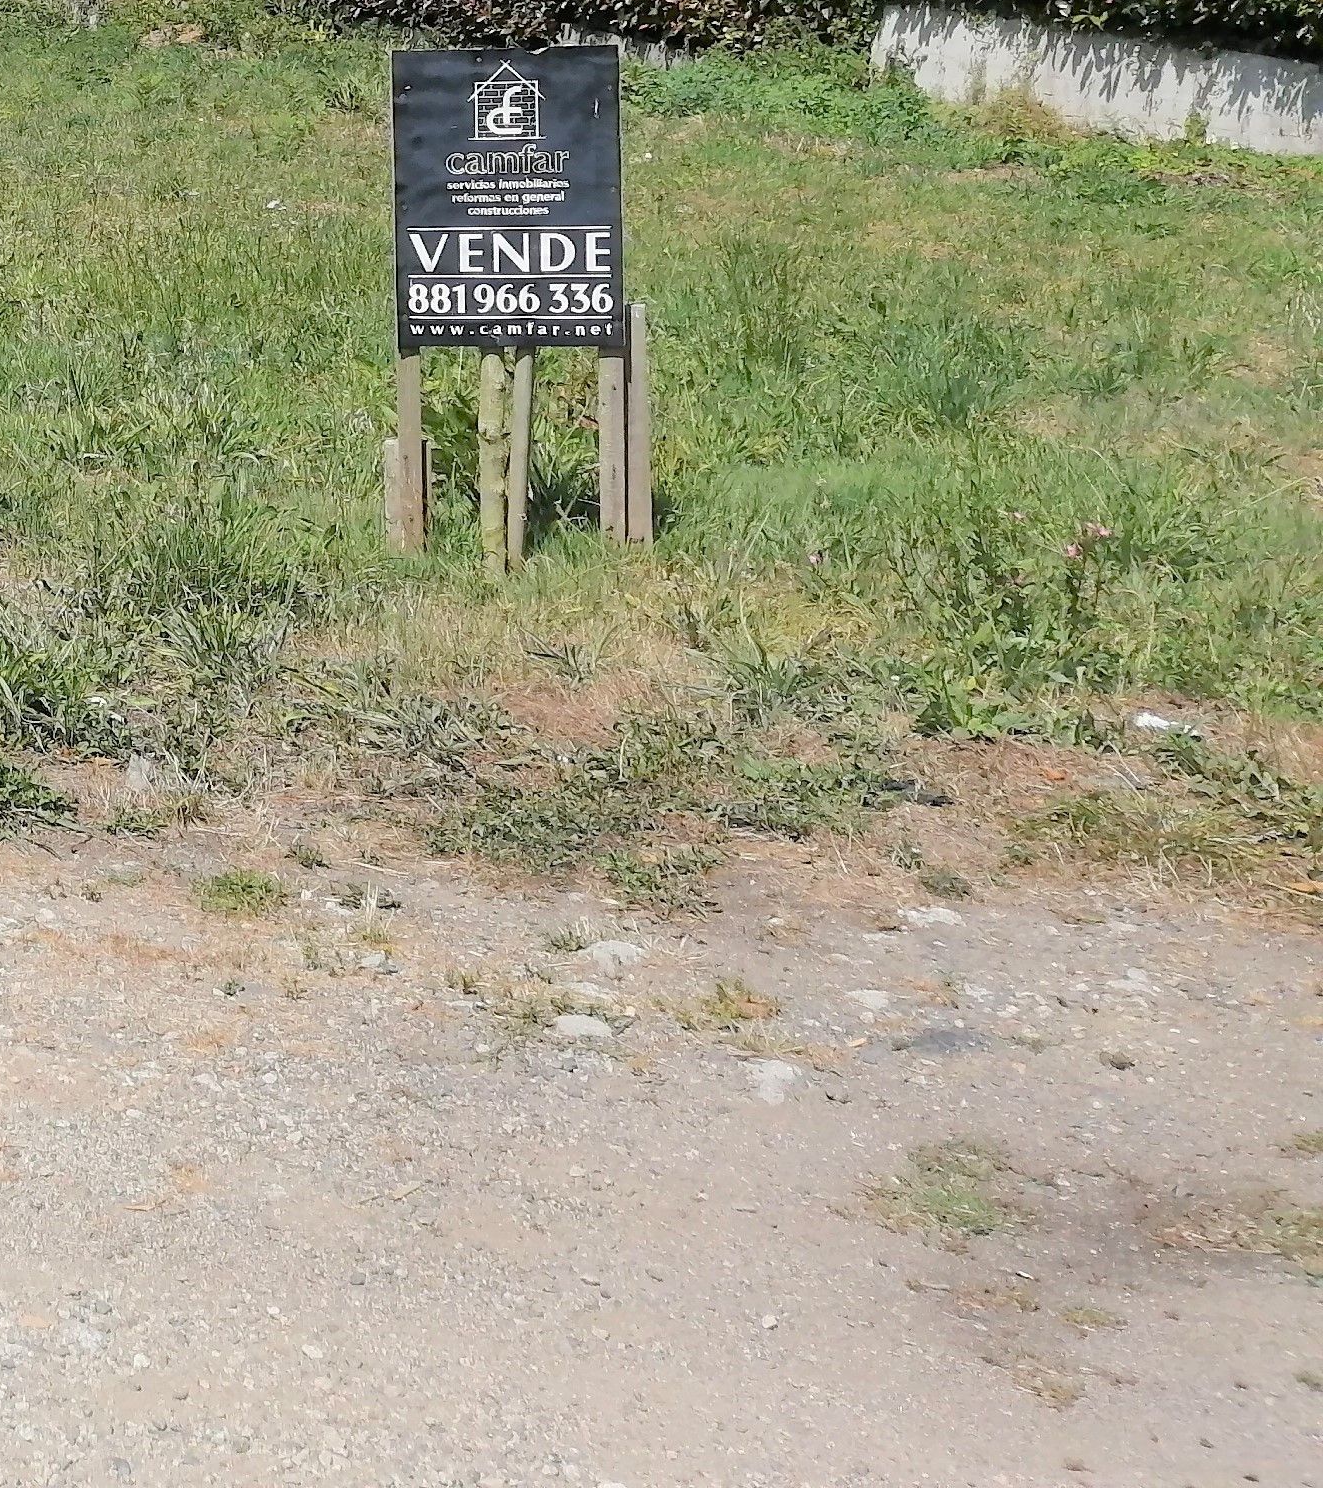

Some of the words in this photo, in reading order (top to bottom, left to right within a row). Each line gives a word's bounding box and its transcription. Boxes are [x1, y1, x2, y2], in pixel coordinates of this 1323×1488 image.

[445, 143, 570, 175] camfar
[446, 179, 496, 190] servicios
[498, 177, 570, 189] inmobiliarios
[451, 193, 502, 203] reformas
[521, 191, 565, 204] general
[467, 205, 550, 216] construcciones
[408, 232, 611, 273] VENDE
[408, 283, 467, 313] 881
[473, 283, 541, 313] 966
[549, 283, 614, 313] 336
[410, 322, 613, 336] www.camfar.net
